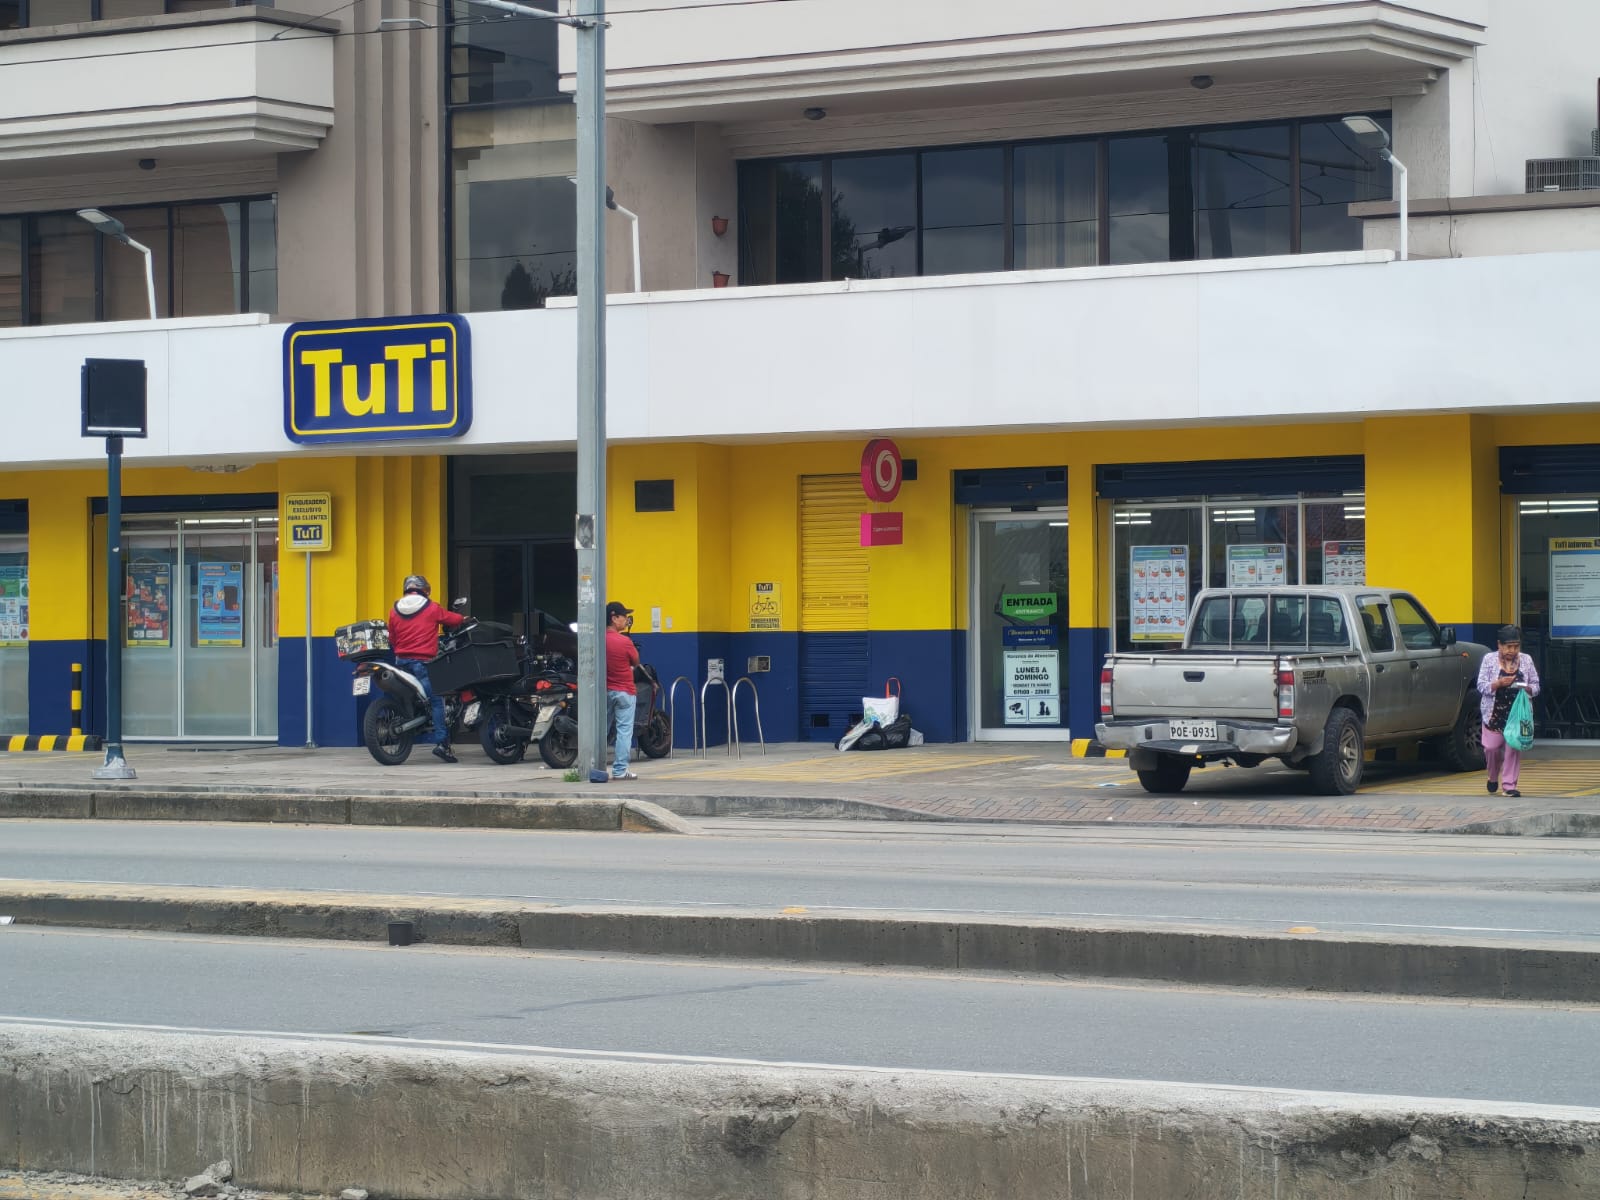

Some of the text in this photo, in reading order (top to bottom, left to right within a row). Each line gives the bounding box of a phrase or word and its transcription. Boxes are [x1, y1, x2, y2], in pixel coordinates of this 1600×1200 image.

[301, 338, 447, 418] TuTi
[295, 527, 320, 538] TuTi
[1006, 597, 1053, 606] ENTRADA
[1170, 726, 1216, 738] POE-0931
